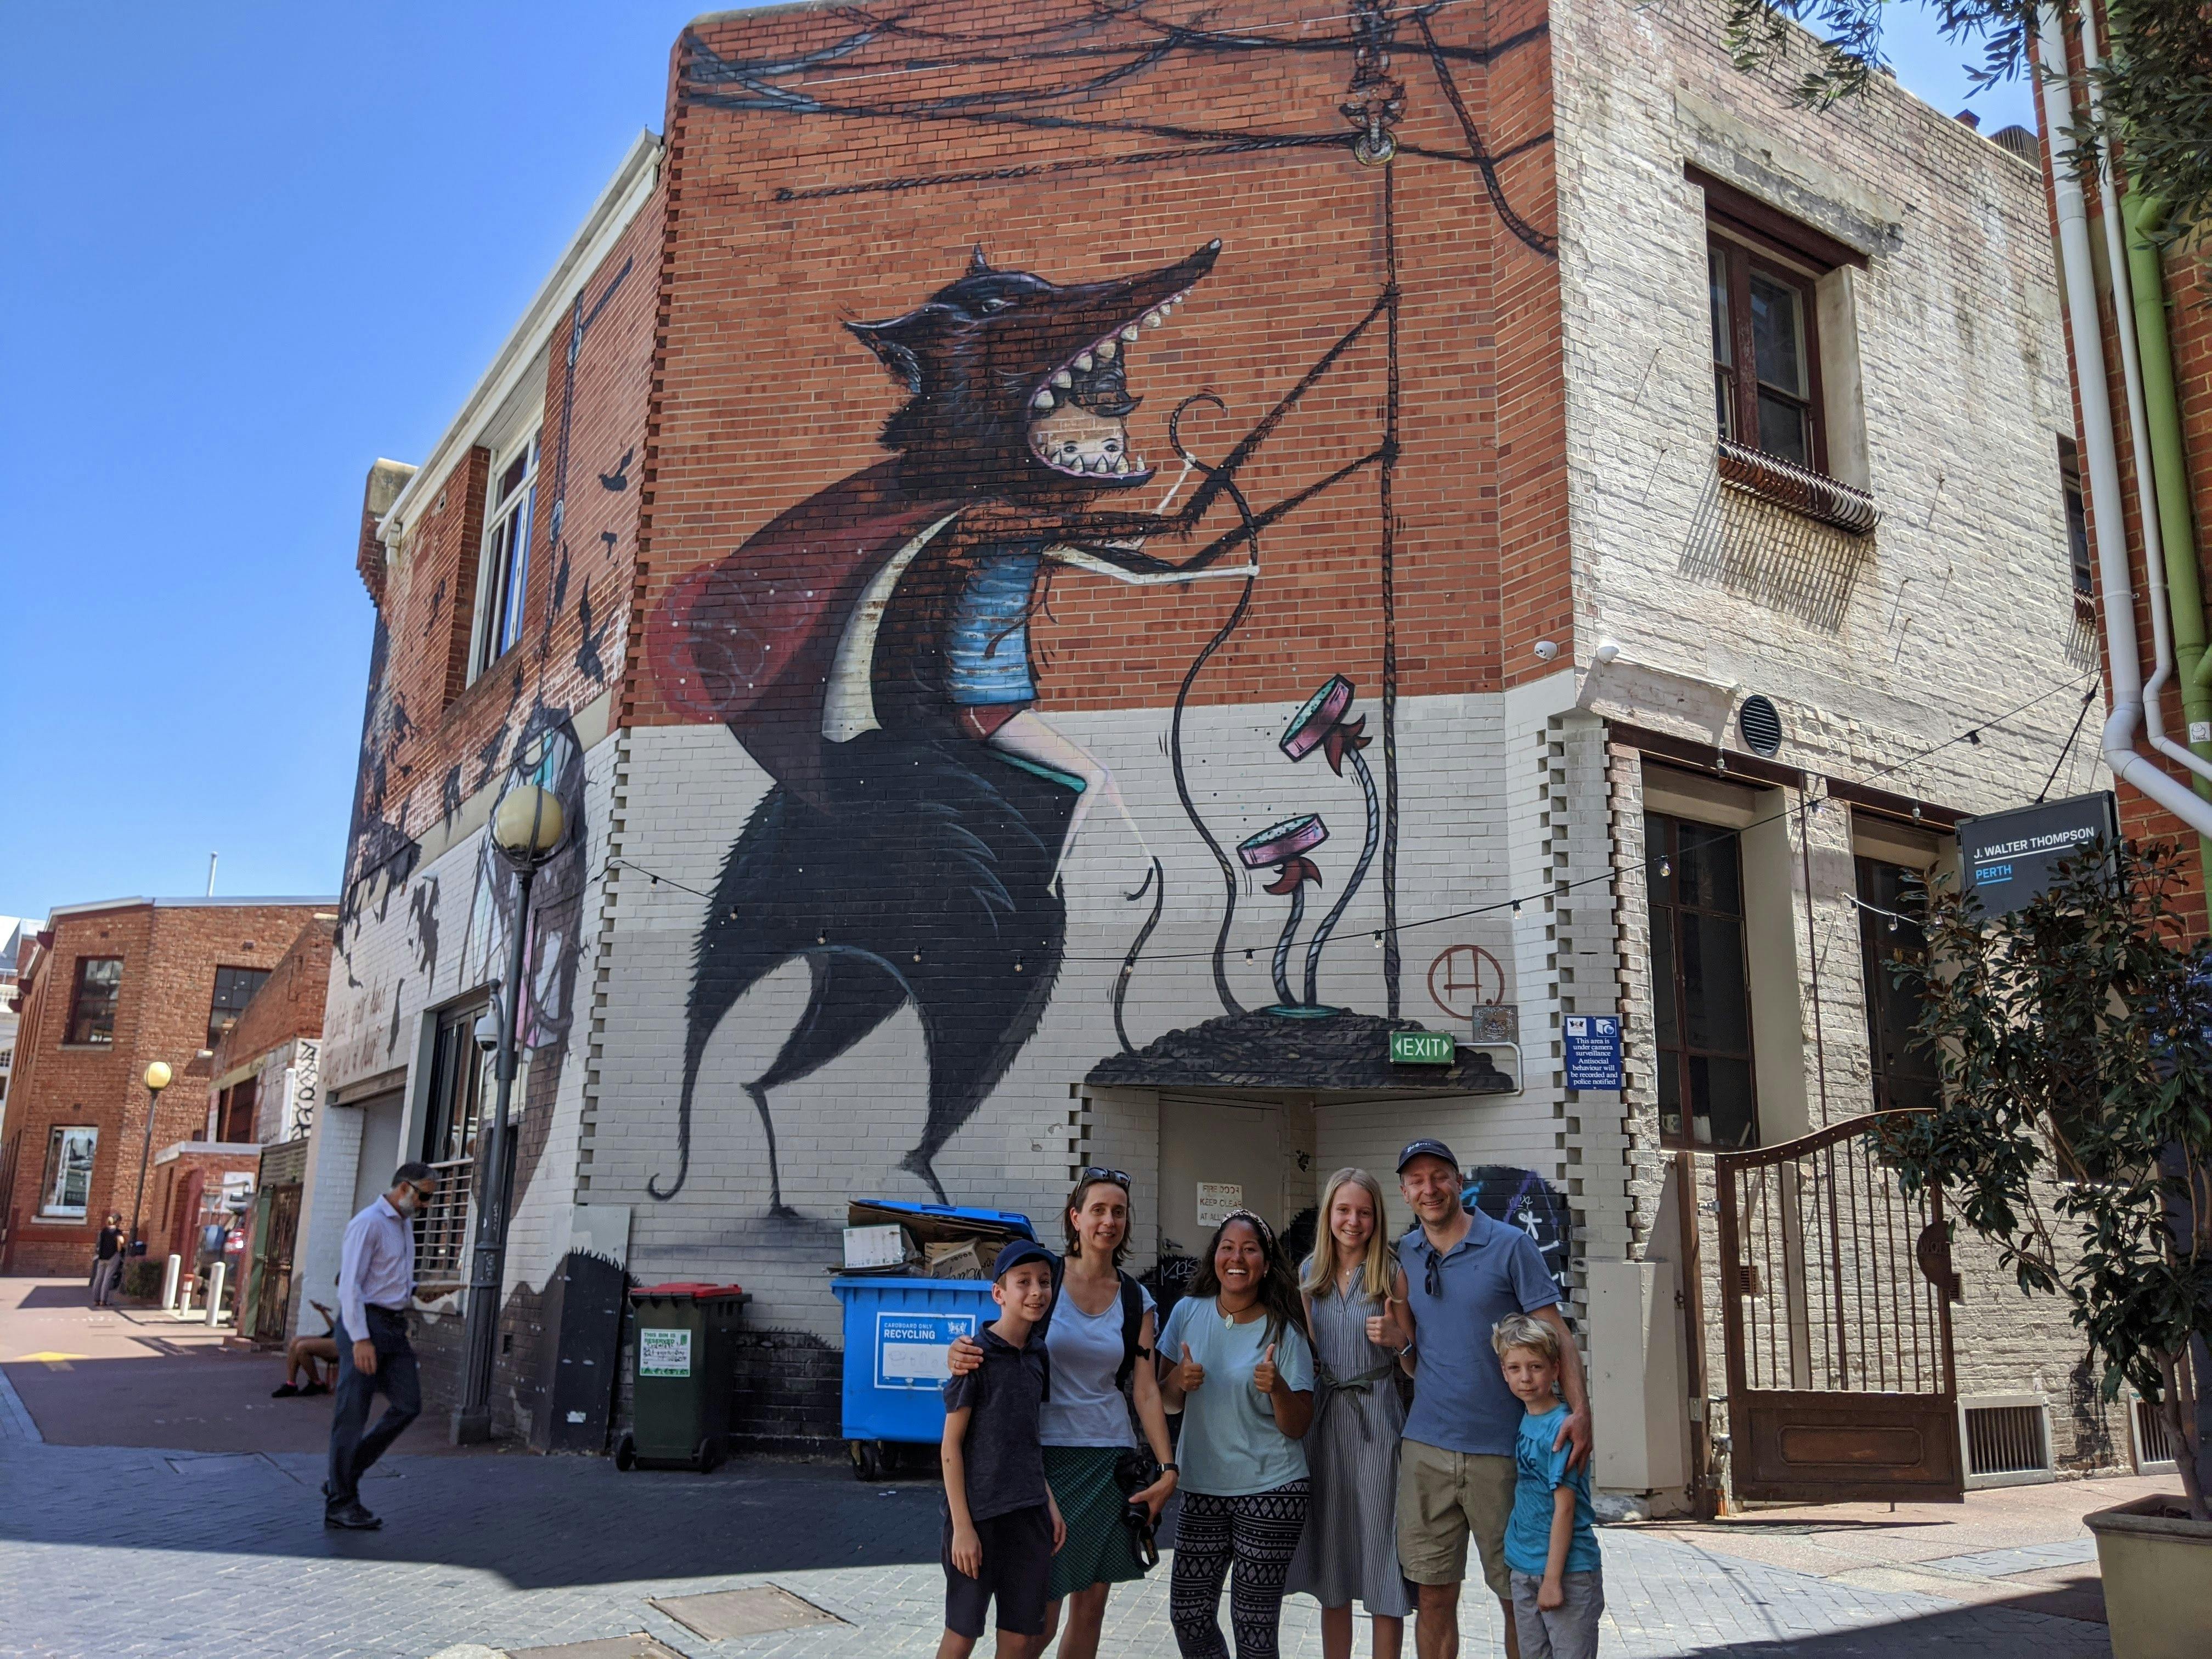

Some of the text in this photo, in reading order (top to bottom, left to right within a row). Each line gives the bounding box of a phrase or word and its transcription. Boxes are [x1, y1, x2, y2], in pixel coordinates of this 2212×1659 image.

[1973, 826, 2095, 859] J. WALTER THOMPSON
[1976, 864, 2012, 879] PERTH
[1403, 1038, 1441, 1056] EXIT
[884, 1329, 935, 1340] RECYCLING
